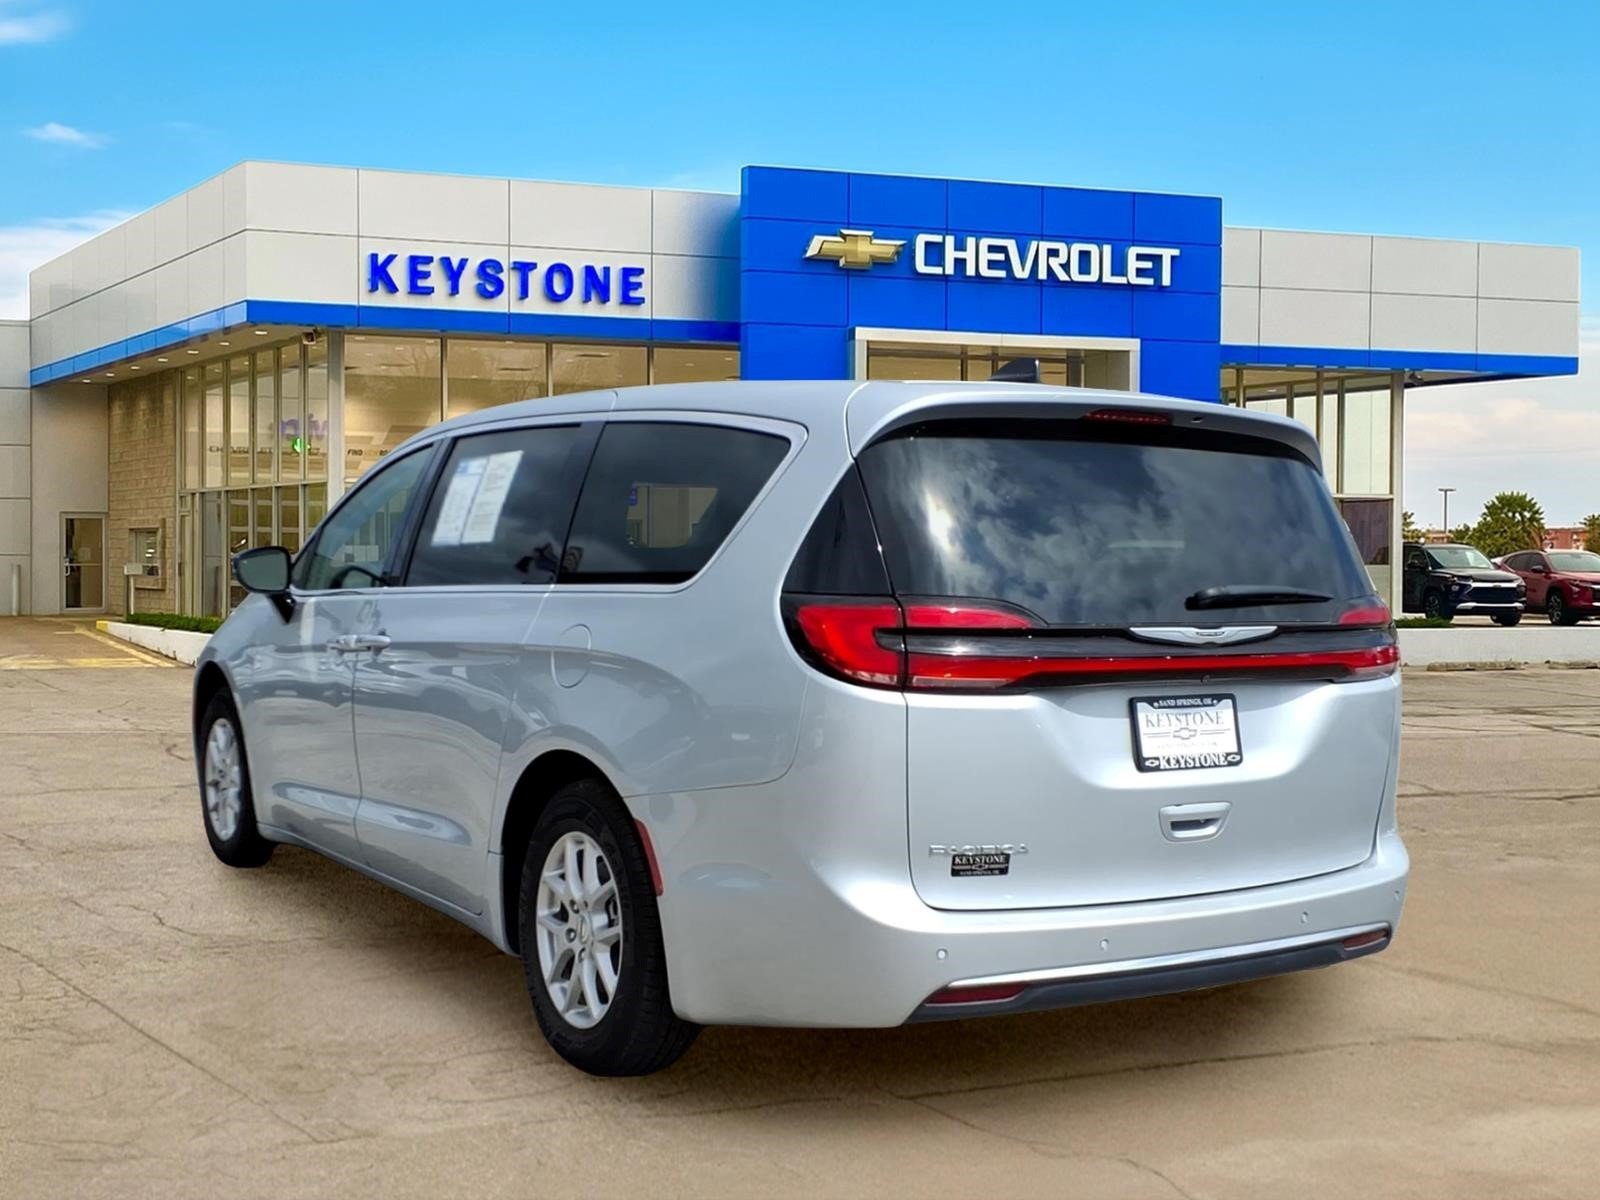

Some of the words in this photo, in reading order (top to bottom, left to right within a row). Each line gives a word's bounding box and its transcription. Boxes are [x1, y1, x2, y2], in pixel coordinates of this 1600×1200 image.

[914, 233, 1181, 287] CHEVROLET
[368, 252, 646, 306] KEYSTONE
[1145, 711, 1224, 728] KEYSTONE
[1159, 752, 1228, 769] KEYSTONE
[928, 843, 1029, 856] PACIFICA
[954, 855, 1006, 865] KEYSTONE
